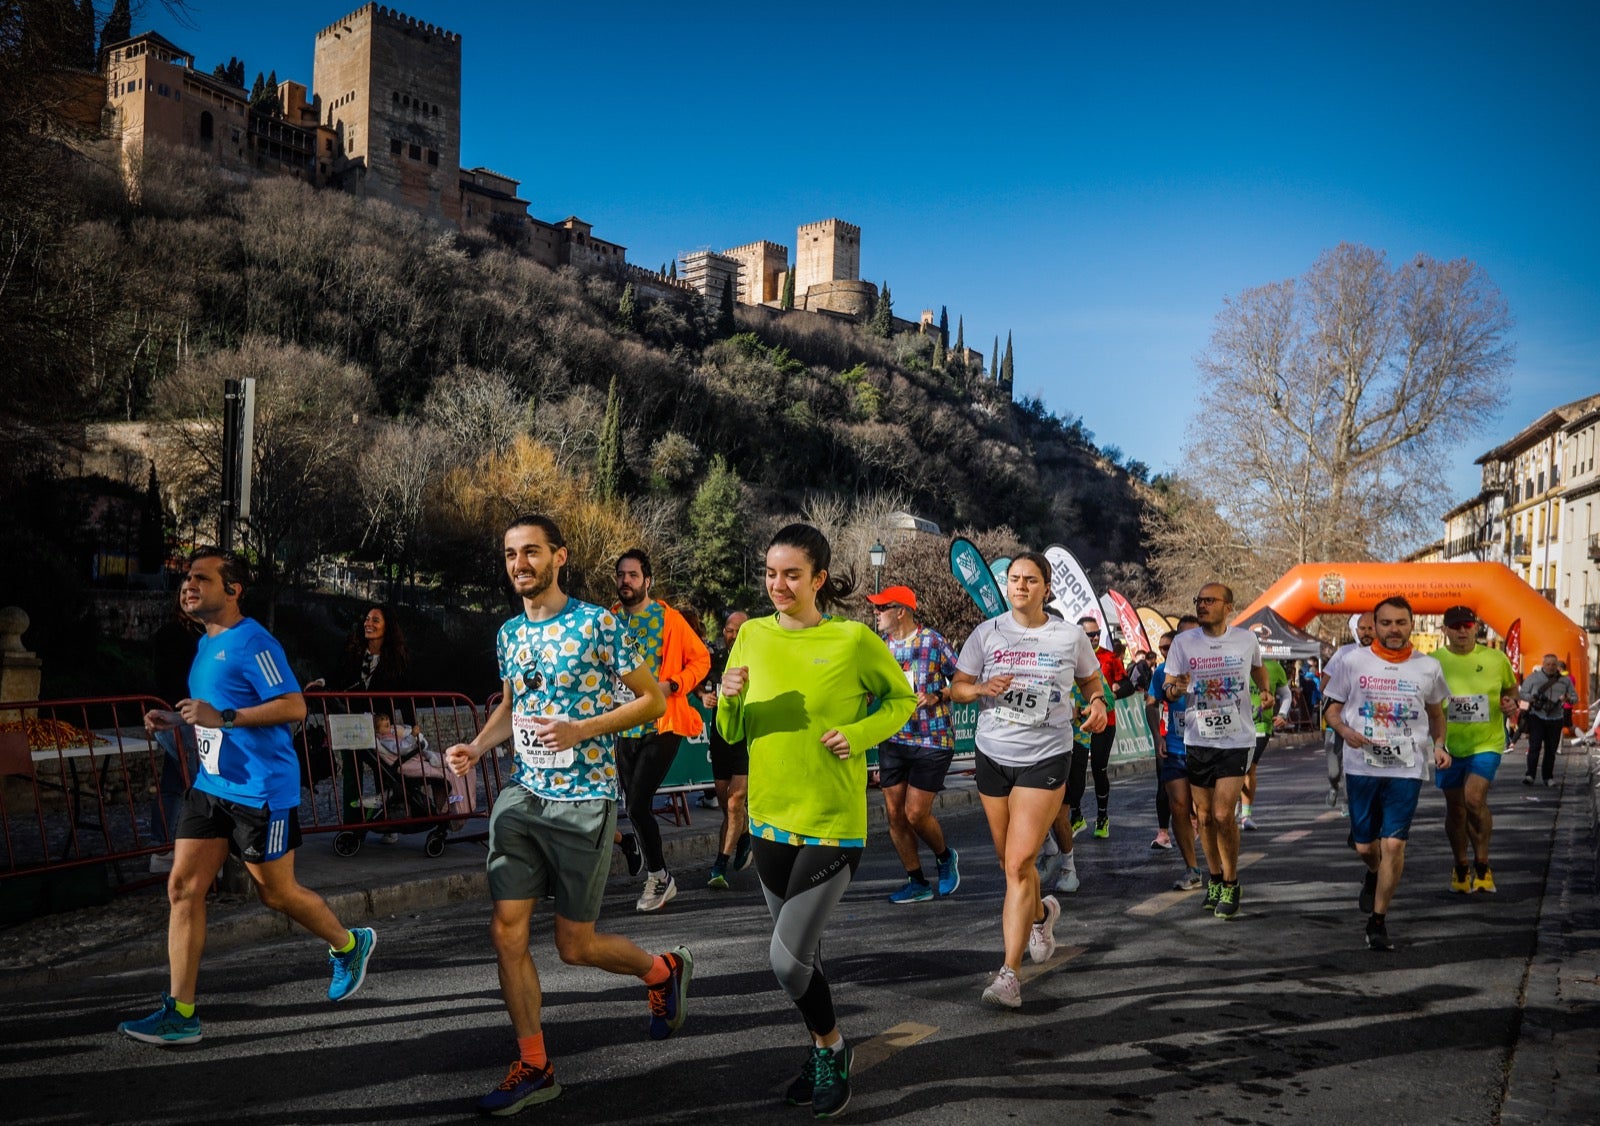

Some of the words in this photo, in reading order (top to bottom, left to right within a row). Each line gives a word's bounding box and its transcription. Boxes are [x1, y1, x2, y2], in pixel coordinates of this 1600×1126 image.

[1408, 591, 1420, 599] de
[1422, 590, 1462, 599] Deportes
[1003, 650, 1036, 658] Carrera
[1359, 675, 1368, 690] 9
[1367, 676, 1397, 685] Carrera
[1003, 689, 1038, 709] 415
[1455, 702, 1480, 712] 264
[1205, 714, 1232, 727] 528
[520, 729, 544, 748] 32
[1372, 745, 1401, 756] 531
[810, 868, 829, 883] JUST
[829, 859, 841, 871] DO
